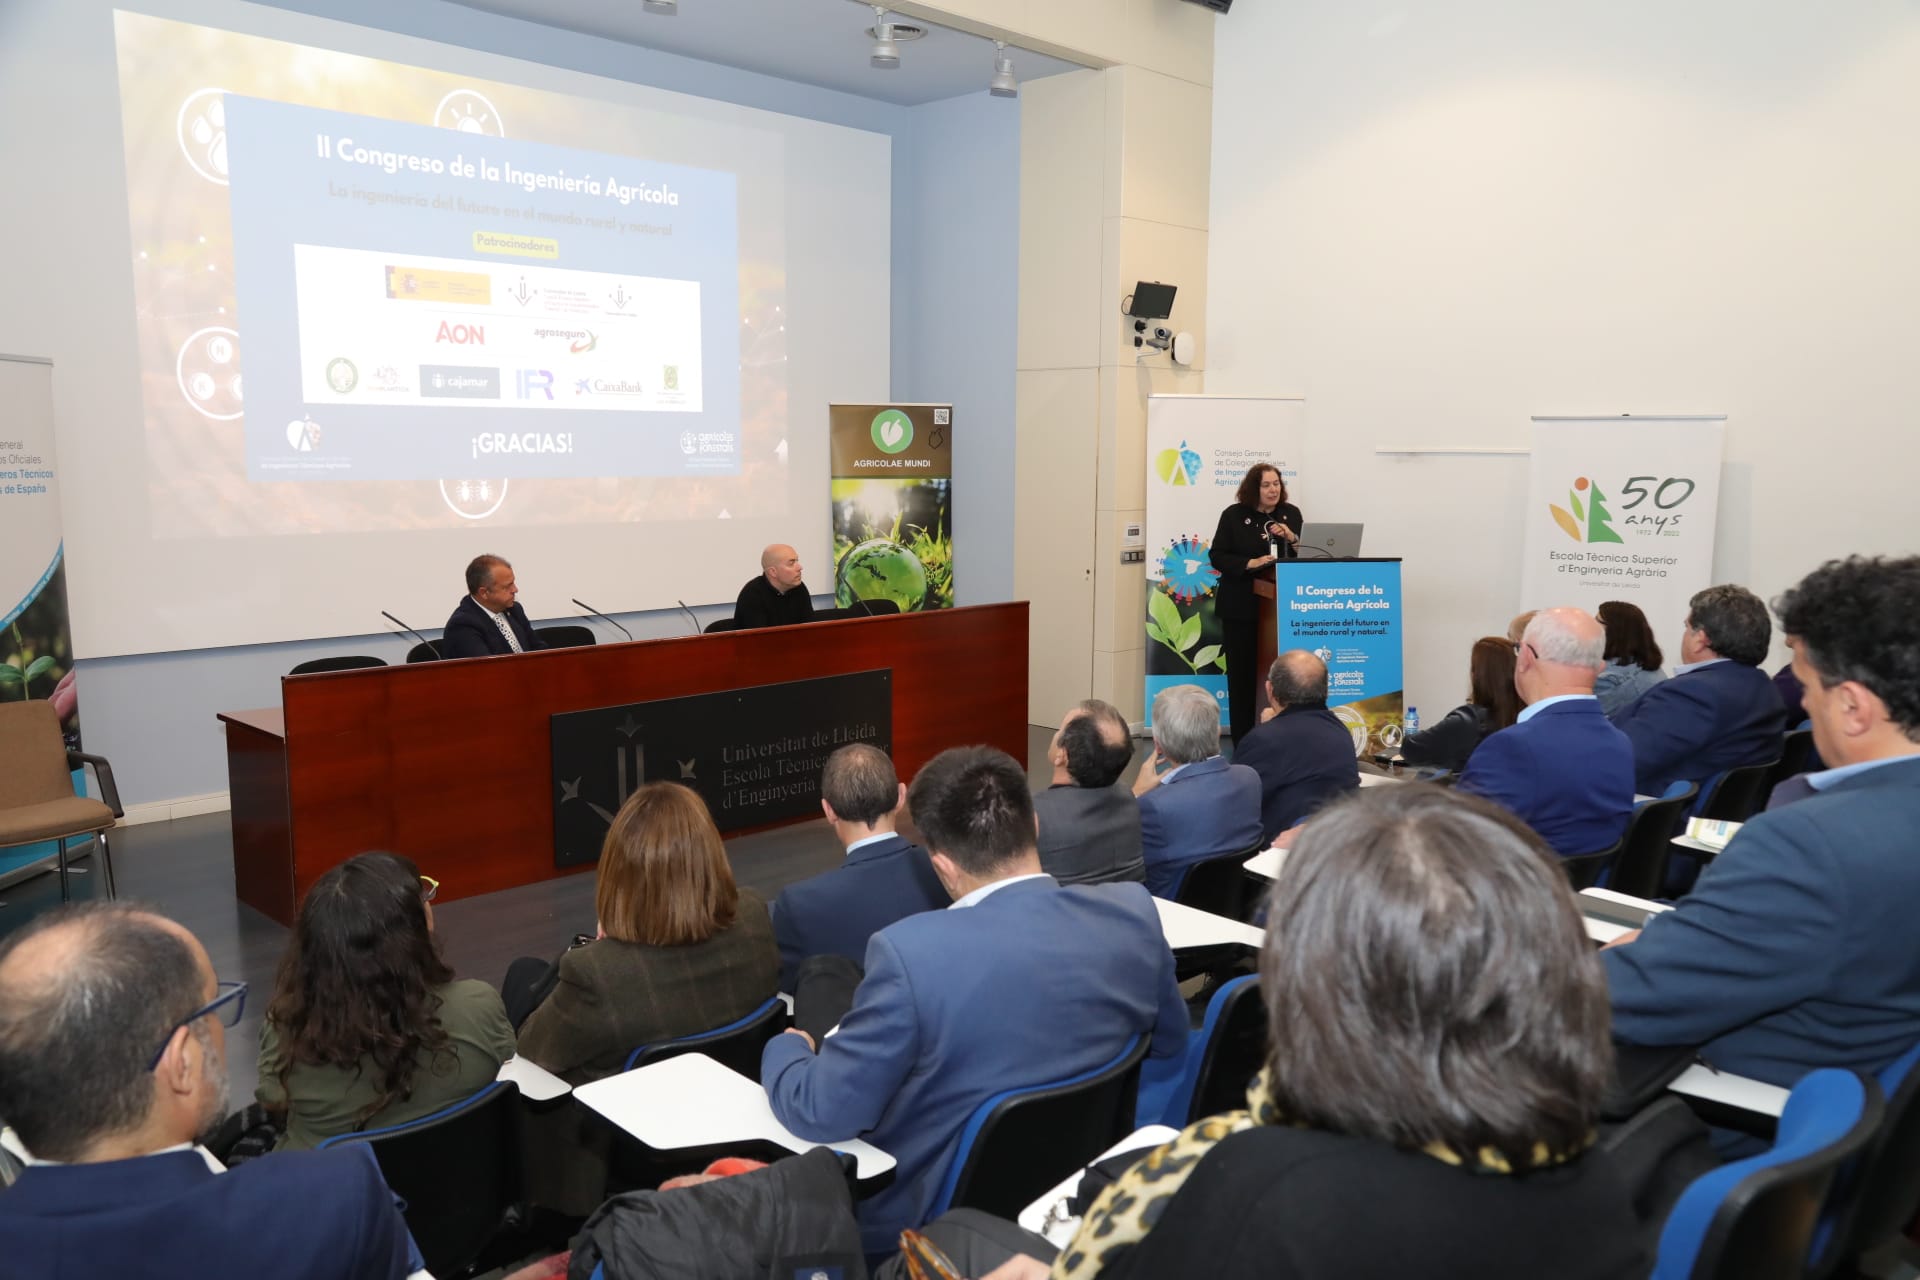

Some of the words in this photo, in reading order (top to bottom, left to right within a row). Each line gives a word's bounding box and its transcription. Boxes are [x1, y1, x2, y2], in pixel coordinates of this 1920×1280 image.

[316, 134, 331, 159] II
[337, 137, 444, 174] Congreso
[449, 154, 476, 179] de
[480, 158, 500, 182] la
[505, 162, 601, 197] Ingeniería
[605, 177, 679, 206] Agrícola
[329, 181, 348, 199] La
[352, 184, 428, 208] ingeniería
[432, 195, 454, 211] del
[457, 197, 500, 217] futuro
[504, 207, 520, 218] en
[524, 205, 535, 220] el
[538, 209, 583, 226] mundo
[585, 214, 616, 231] rural
[617, 221, 627, 235] y
[629, 219, 673, 237] natural
[476, 233, 555, 254] Patrocinadores
[435, 319, 485, 345] AON
[533, 327, 586, 340] agroseguro
[448, 375, 488, 390] cajamar
[594, 378, 642, 394] CaixaBank
[0, 440, 24, 449] eneral
[472, 431, 574, 458] ¡GRACIAS!
[9, 454, 42, 464] Oficiales
[1214, 449, 1243, 458] Consejo
[1244, 449, 1272, 457] General
[854, 459, 902, 468] AGRICOLAE
[905, 459, 931, 468] MUNDI
[5, 484, 15, 494] de
[17, 483, 46, 496] España
[1622, 476, 1695, 509] 50
[1625, 514, 1683, 536] anys
[1550, 551, 1584, 561] Escola
[1586, 551, 1629, 563] Tècnica
[1632, 554, 1678, 566] Superior
[1558, 563, 1623, 577] d'Enginyeria
[1625, 567, 1667, 579] Agrària
[1296, 585, 1304, 596] II
[1305, 585, 1356, 598] Congreso
[1358, 584, 1371, 596] de
[1374, 584, 1383, 595] la
[1290, 599, 1344, 613] Ingeniería
[1346, 598, 1390, 612] Agrícola
[1291, 619, 1300, 627] La
[1342, 618, 1354, 627] del
[1355, 619, 1379, 627] futuro
[1293, 628, 1301, 636] el
[1301, 628, 1328, 637] mundo
[1330, 628, 1350, 636] rural
[1350, 629, 1356, 638] y
[722, 738, 807, 764] Universitat
[811, 731, 830, 748] de
[833, 722, 876, 744] Lleida
[722, 765, 770, 787] Escola
[722, 776, 816, 810] d'Enginyeria
